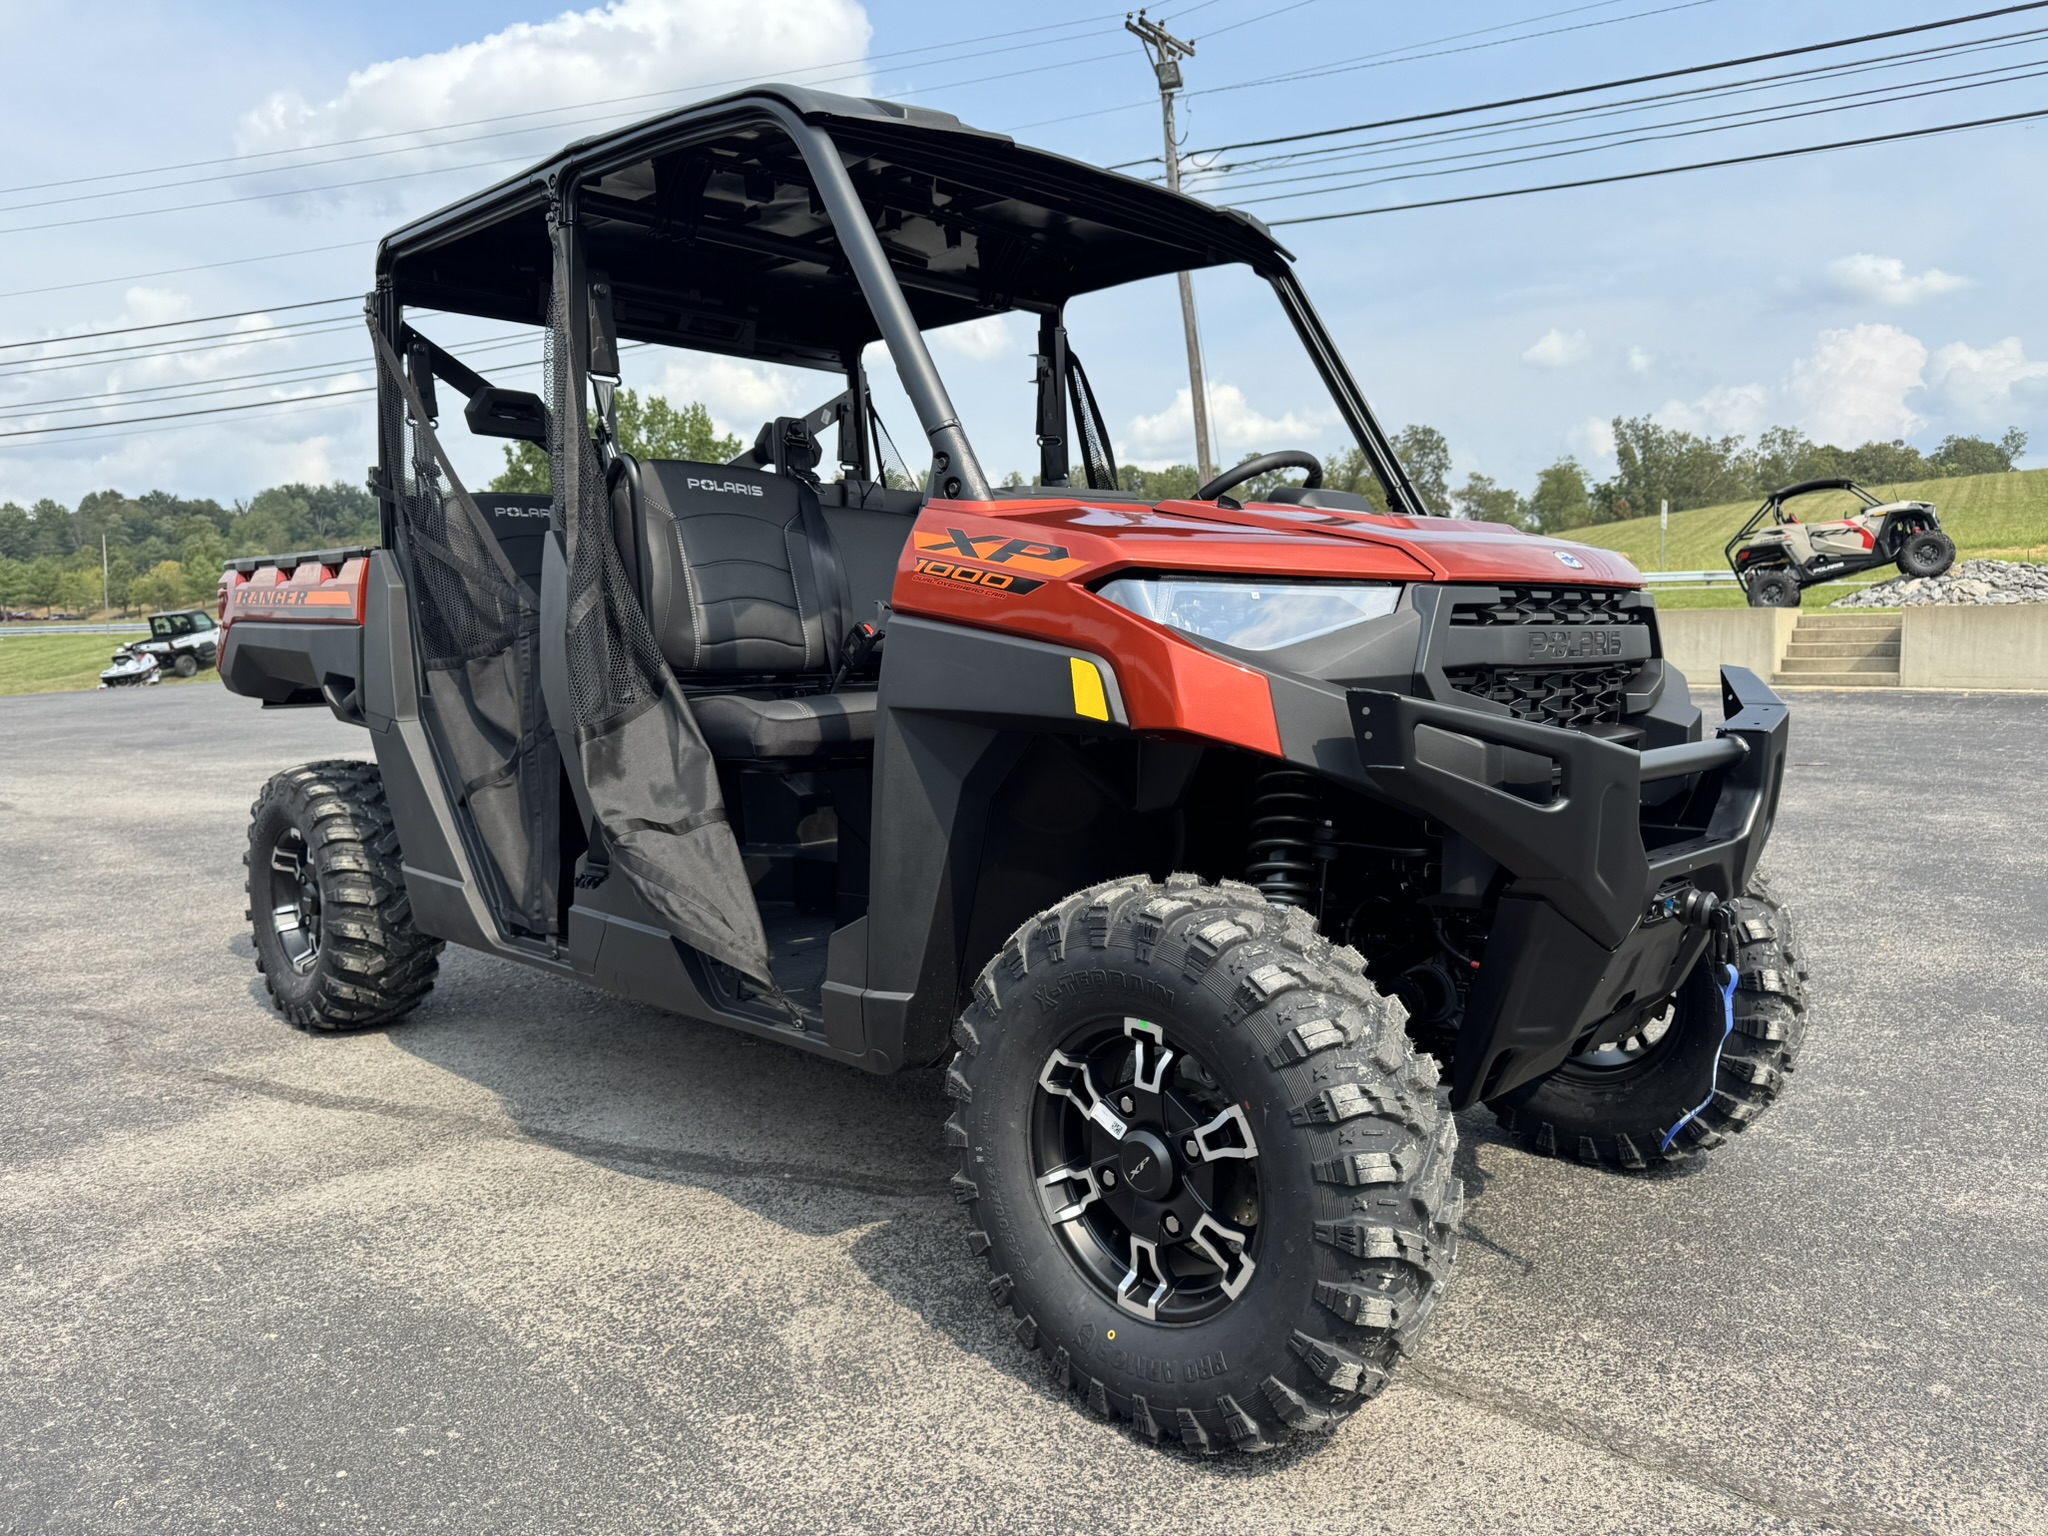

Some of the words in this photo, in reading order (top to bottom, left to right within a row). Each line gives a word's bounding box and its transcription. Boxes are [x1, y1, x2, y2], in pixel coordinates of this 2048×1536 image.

[686, 477, 764, 497] POLARIS
[493, 507, 550, 518] POLAR
[919, 527, 1070, 564] XP
[913, 559, 1014, 590] 1000
[1812, 561, 1845, 574] POLARIS
[240, 590, 308, 606] RANGER
[912, 575, 935, 585] DUAL
[936, 580, 984, 594] OVERHEAD
[985, 589, 1007, 599] CAM
[1528, 630, 1622, 660] POLARIS
[1032, 969, 1176, 1012] X-TERRAIN
[1129, 1156, 1151, 1181] XP
[1182, 1350, 1228, 1383] PRO
